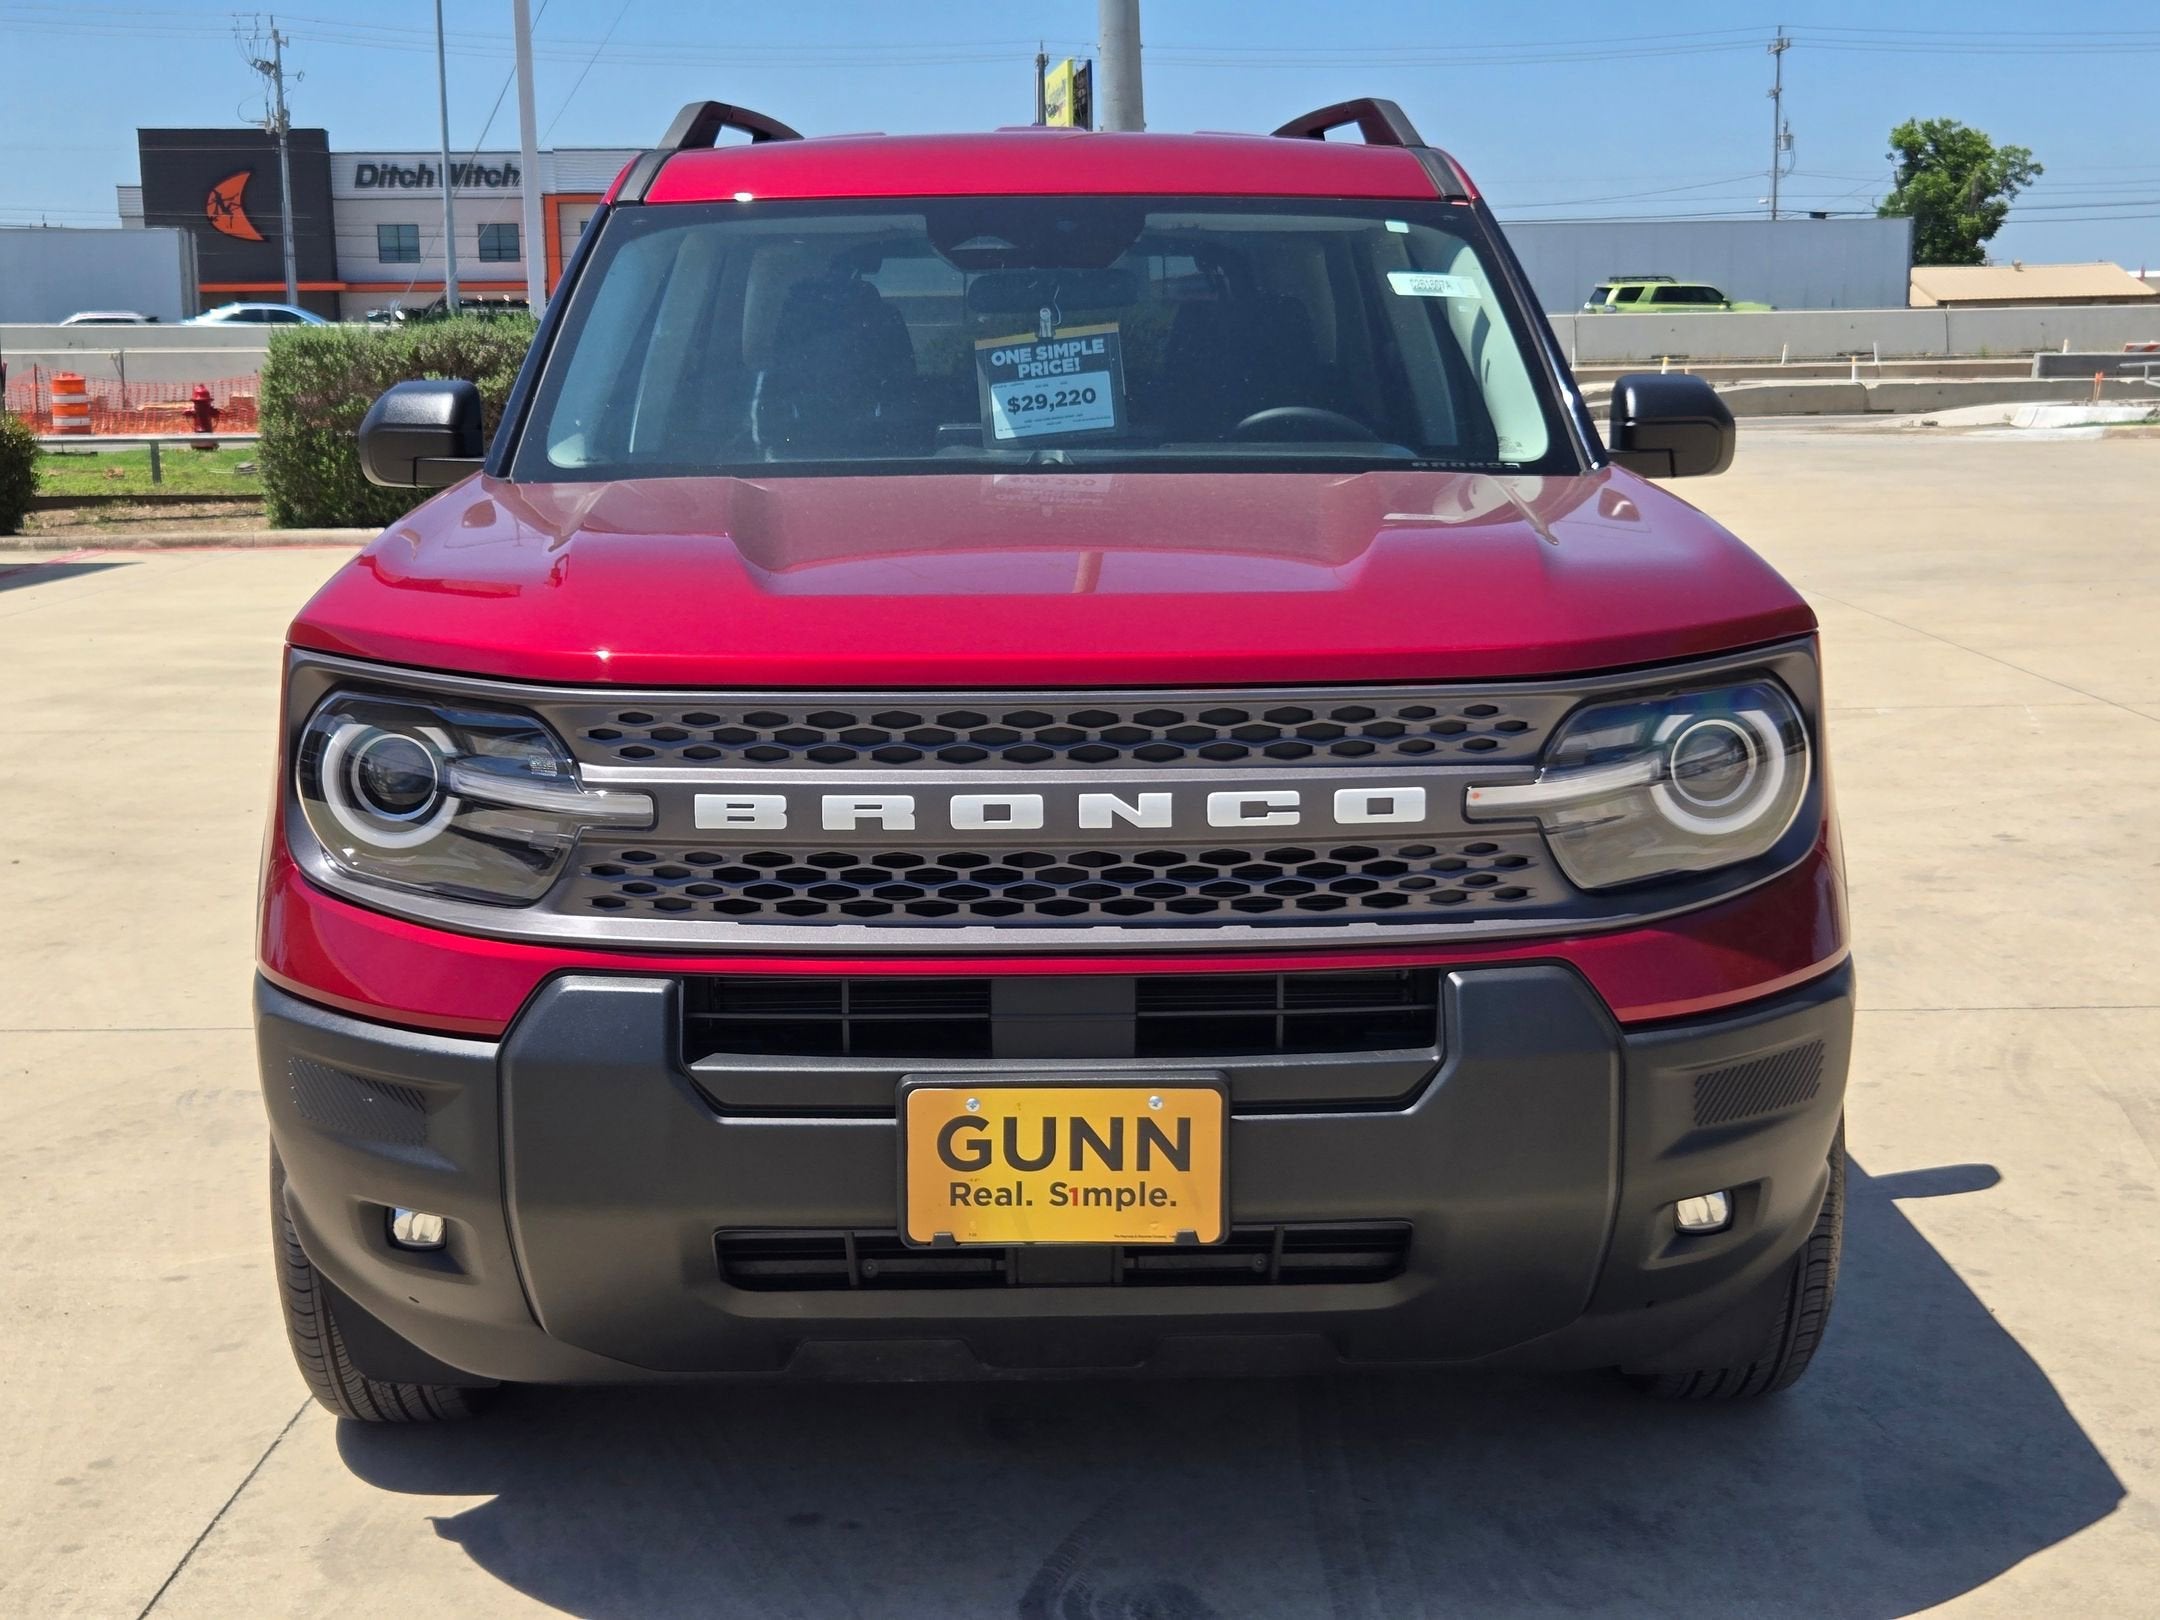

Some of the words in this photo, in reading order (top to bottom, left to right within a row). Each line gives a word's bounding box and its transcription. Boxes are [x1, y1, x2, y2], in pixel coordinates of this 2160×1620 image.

[354, 163, 435, 188] Ditch
[438, 162, 521, 188] Witch
[991, 348, 1032, 367] ONE
[1036, 338, 1105, 361] SIMPLE
[1017, 357, 1081, 379] PRICE!
[1007, 387, 1096, 416] $29,220
[694, 785, 1427, 831] BRONCO
[936, 1114, 1191, 1172] GUNN
[950, 1181, 1033, 1207] Real.
[1049, 1181, 1177, 1212] S1mple.
